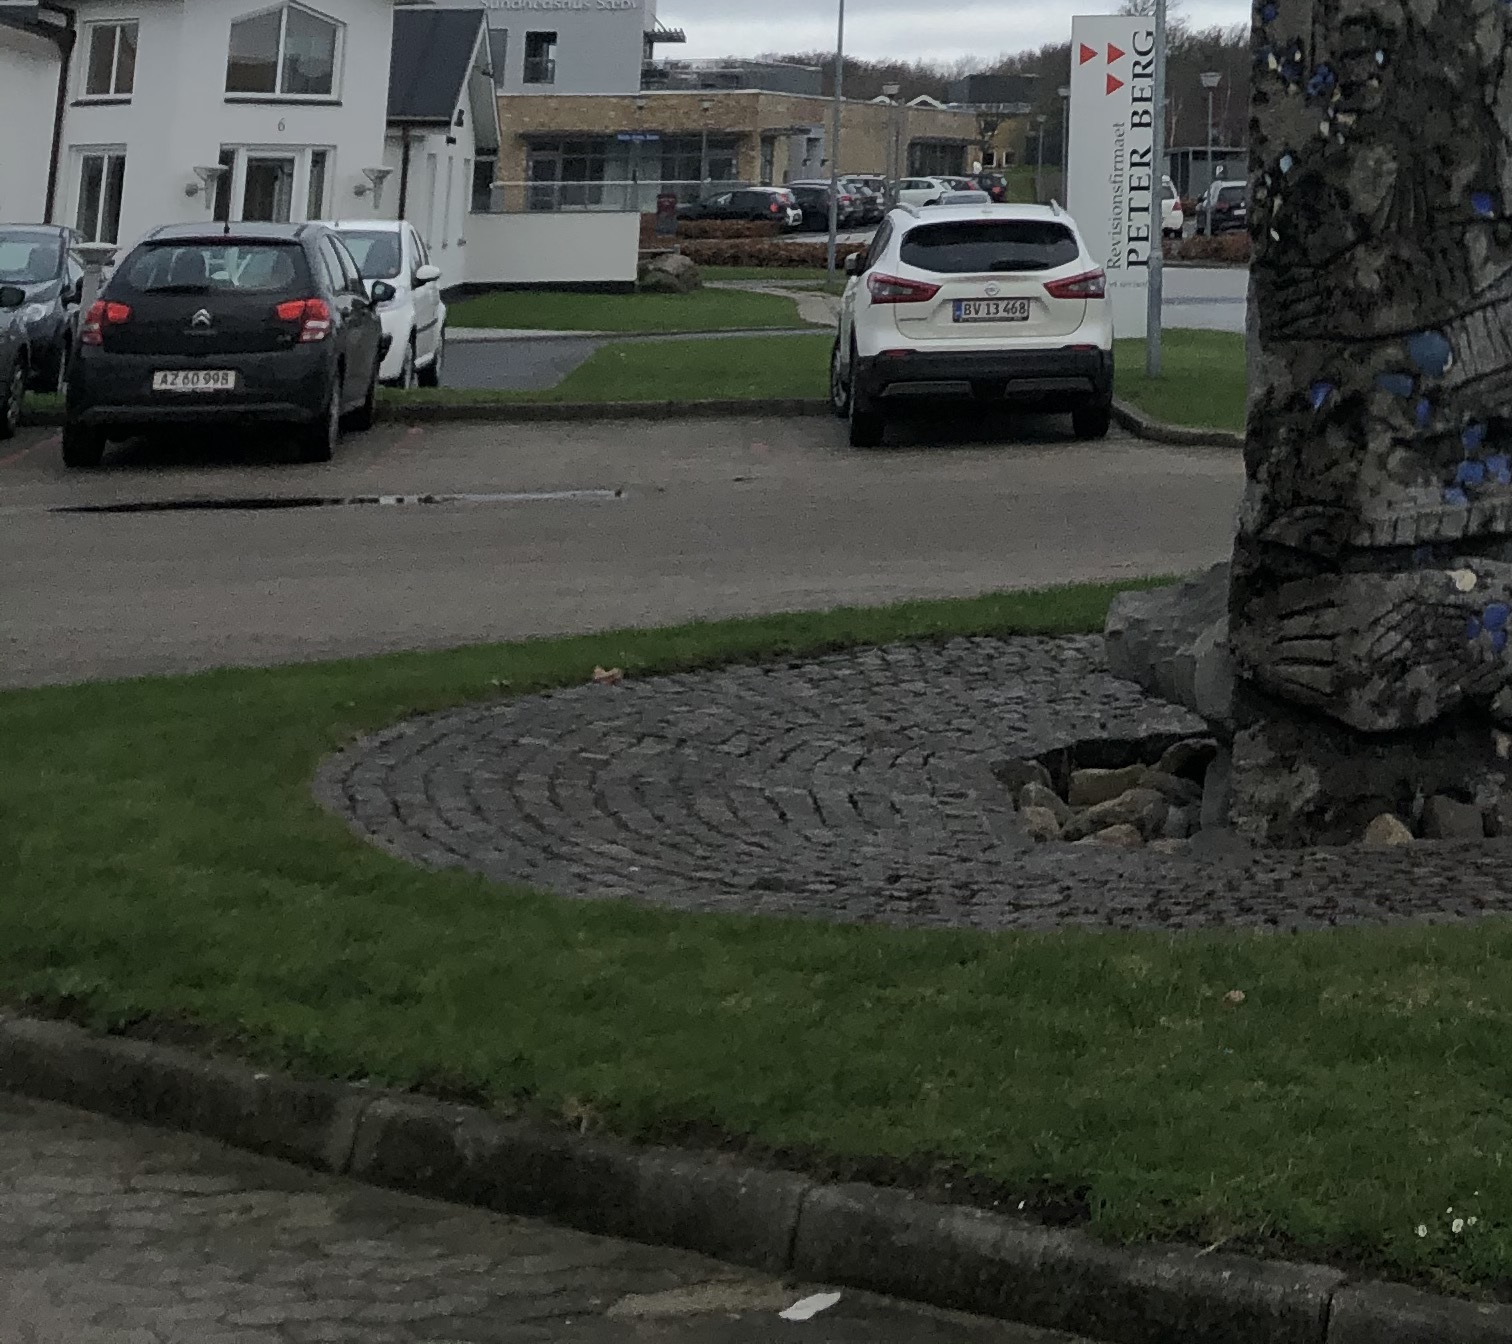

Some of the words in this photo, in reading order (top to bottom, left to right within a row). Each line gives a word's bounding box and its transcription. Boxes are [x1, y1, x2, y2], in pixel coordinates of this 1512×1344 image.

[1130, 30, 1155, 130] BERG
[277, 117, 286, 132] 6
[1107, 121, 1126, 270] Revisionsfirmaet
[1127, 145, 1152, 270] PETER
[963, 303, 981, 316] BV
[985, 302, 1000, 315] 13
[1003, 301, 1027, 315] 468
[160, 372, 179, 387] AZ
[182, 372, 200, 387] 60
[203, 372, 229, 387] 998
